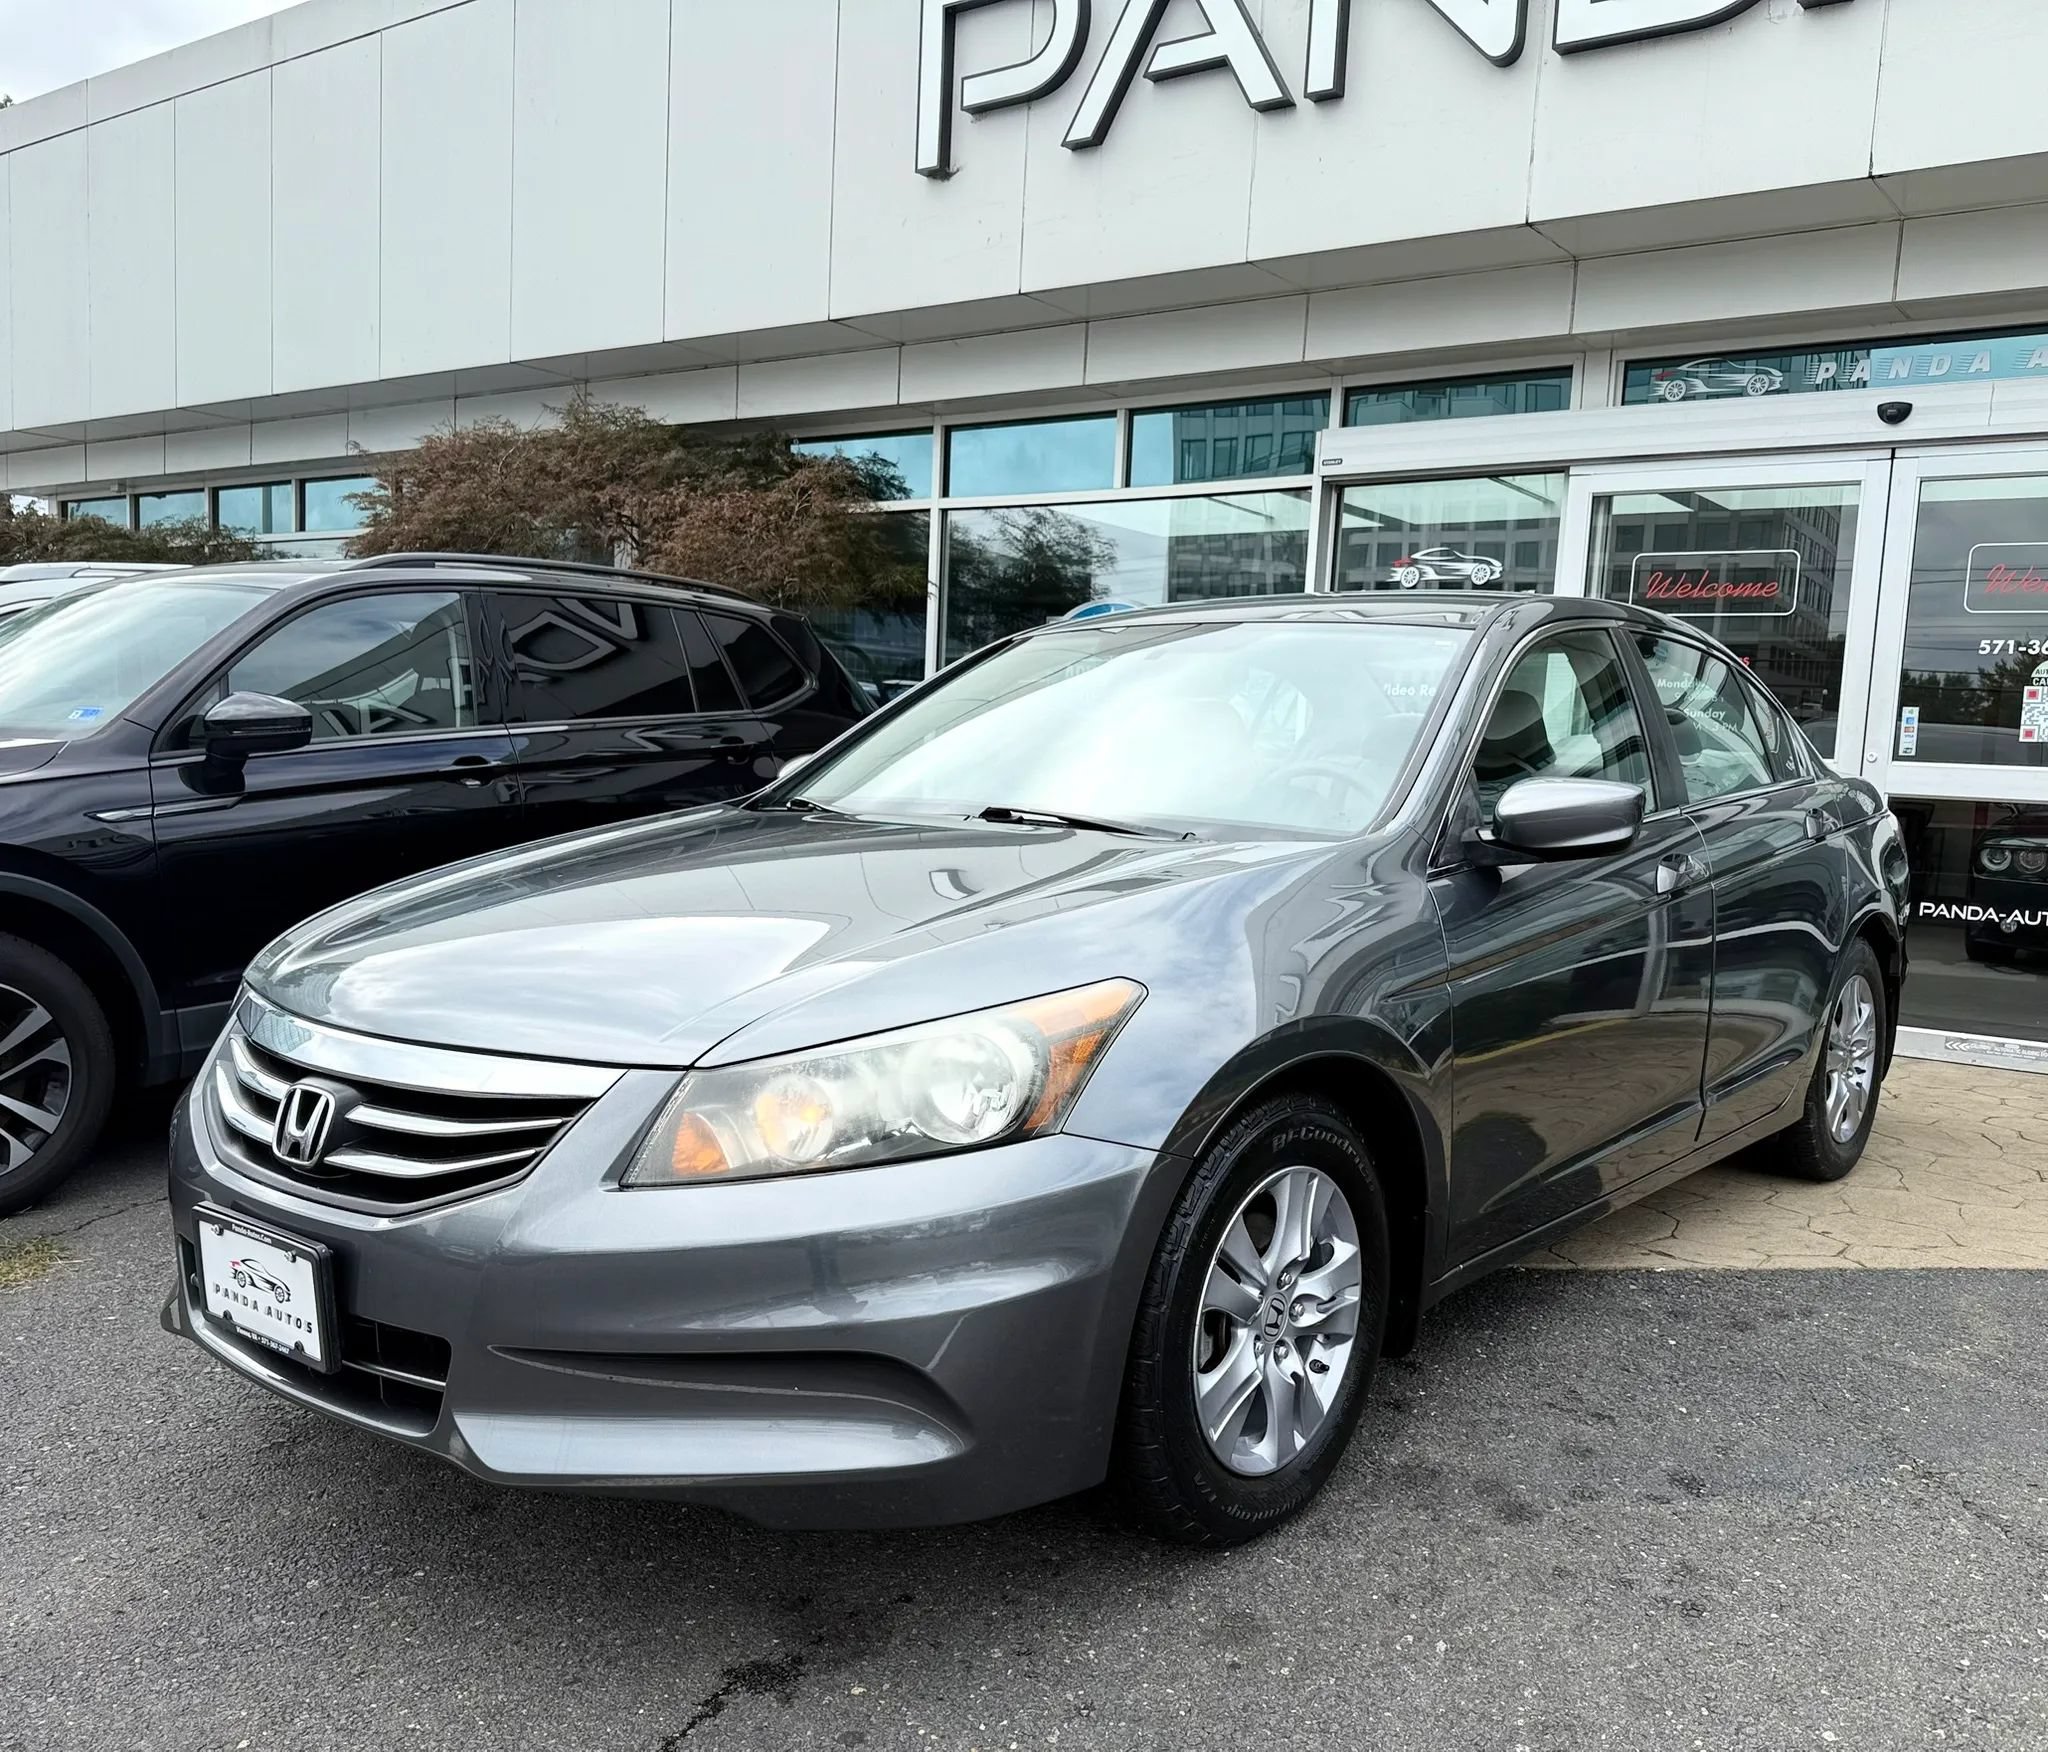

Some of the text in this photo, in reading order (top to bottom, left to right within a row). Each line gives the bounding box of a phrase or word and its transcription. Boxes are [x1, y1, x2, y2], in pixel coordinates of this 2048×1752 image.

[1813, 348, 1991, 385] PANDA
[1646, 568, 1780, 599] Welcome
[1984, 563, 2048, 593] We
[2032, 677, 2048, 686] CA
[1684, 708, 1726, 720] Sunday
[214, 1283, 313, 1333] PANDA AUTOS
